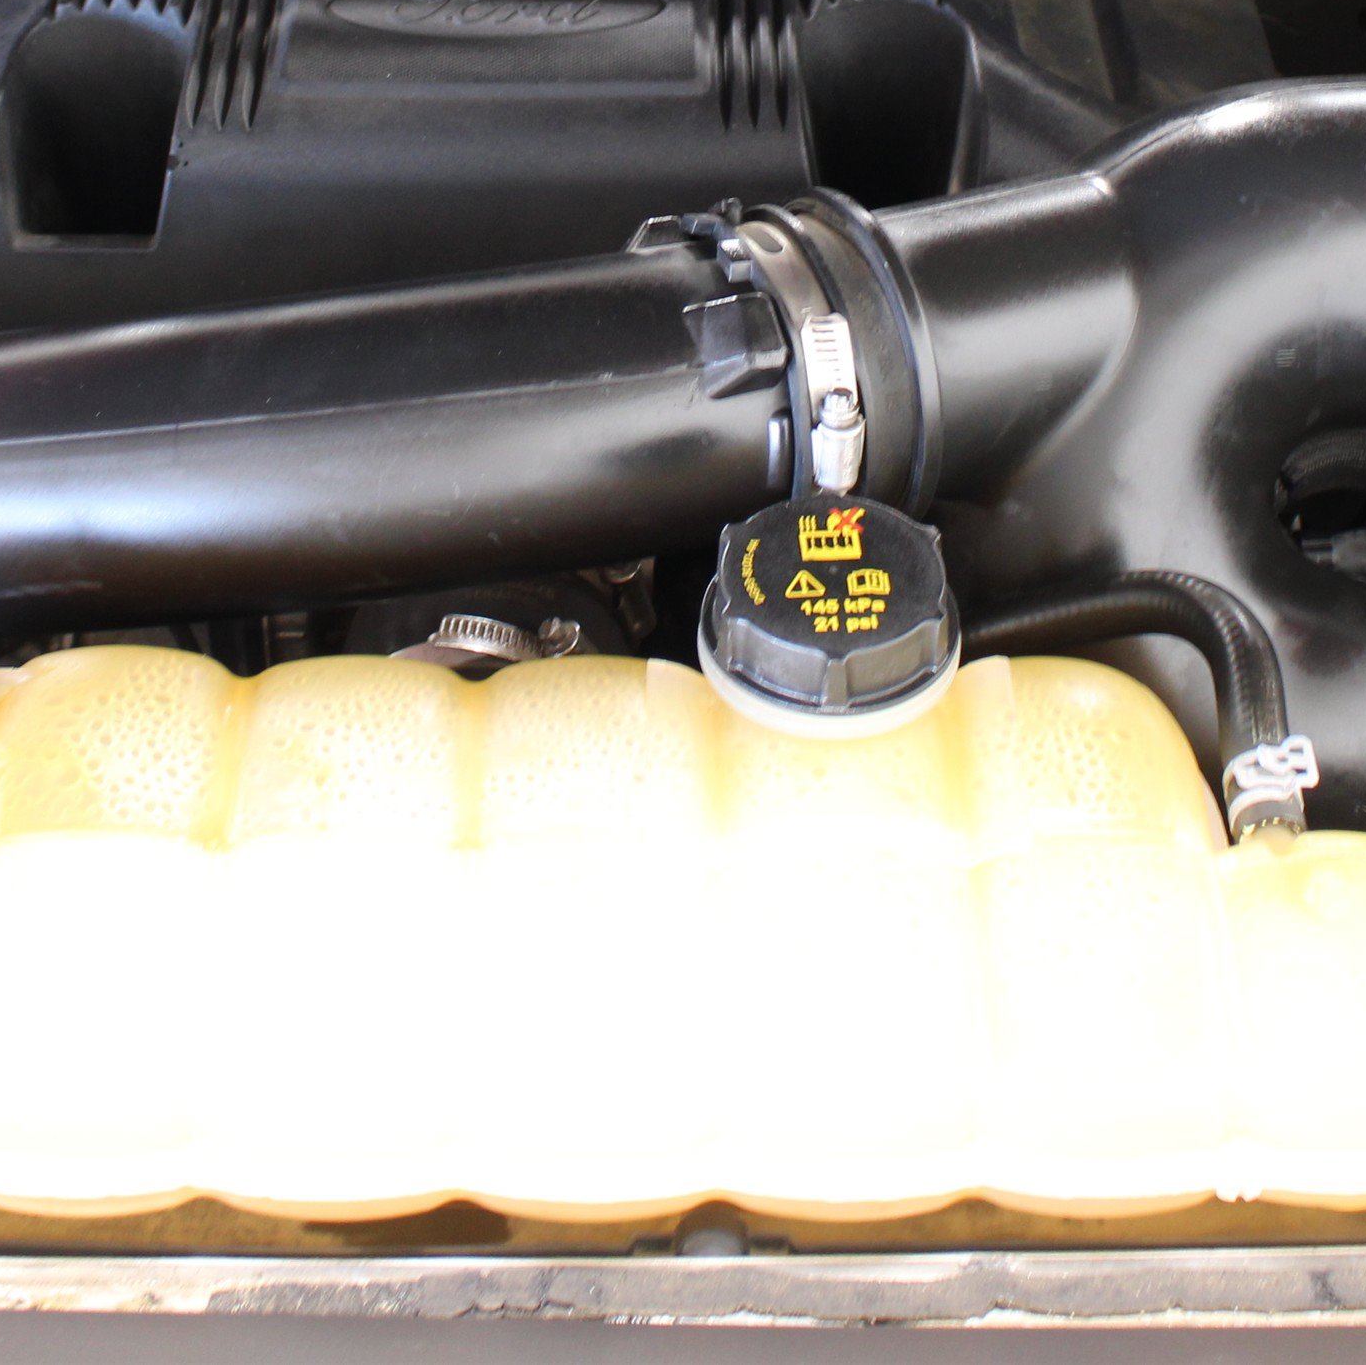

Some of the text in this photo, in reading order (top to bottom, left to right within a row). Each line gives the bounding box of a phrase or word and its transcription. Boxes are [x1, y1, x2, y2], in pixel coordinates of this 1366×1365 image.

[800, 596, 886, 616] 145 kPa
[813, 613, 879, 634] 21 psi
